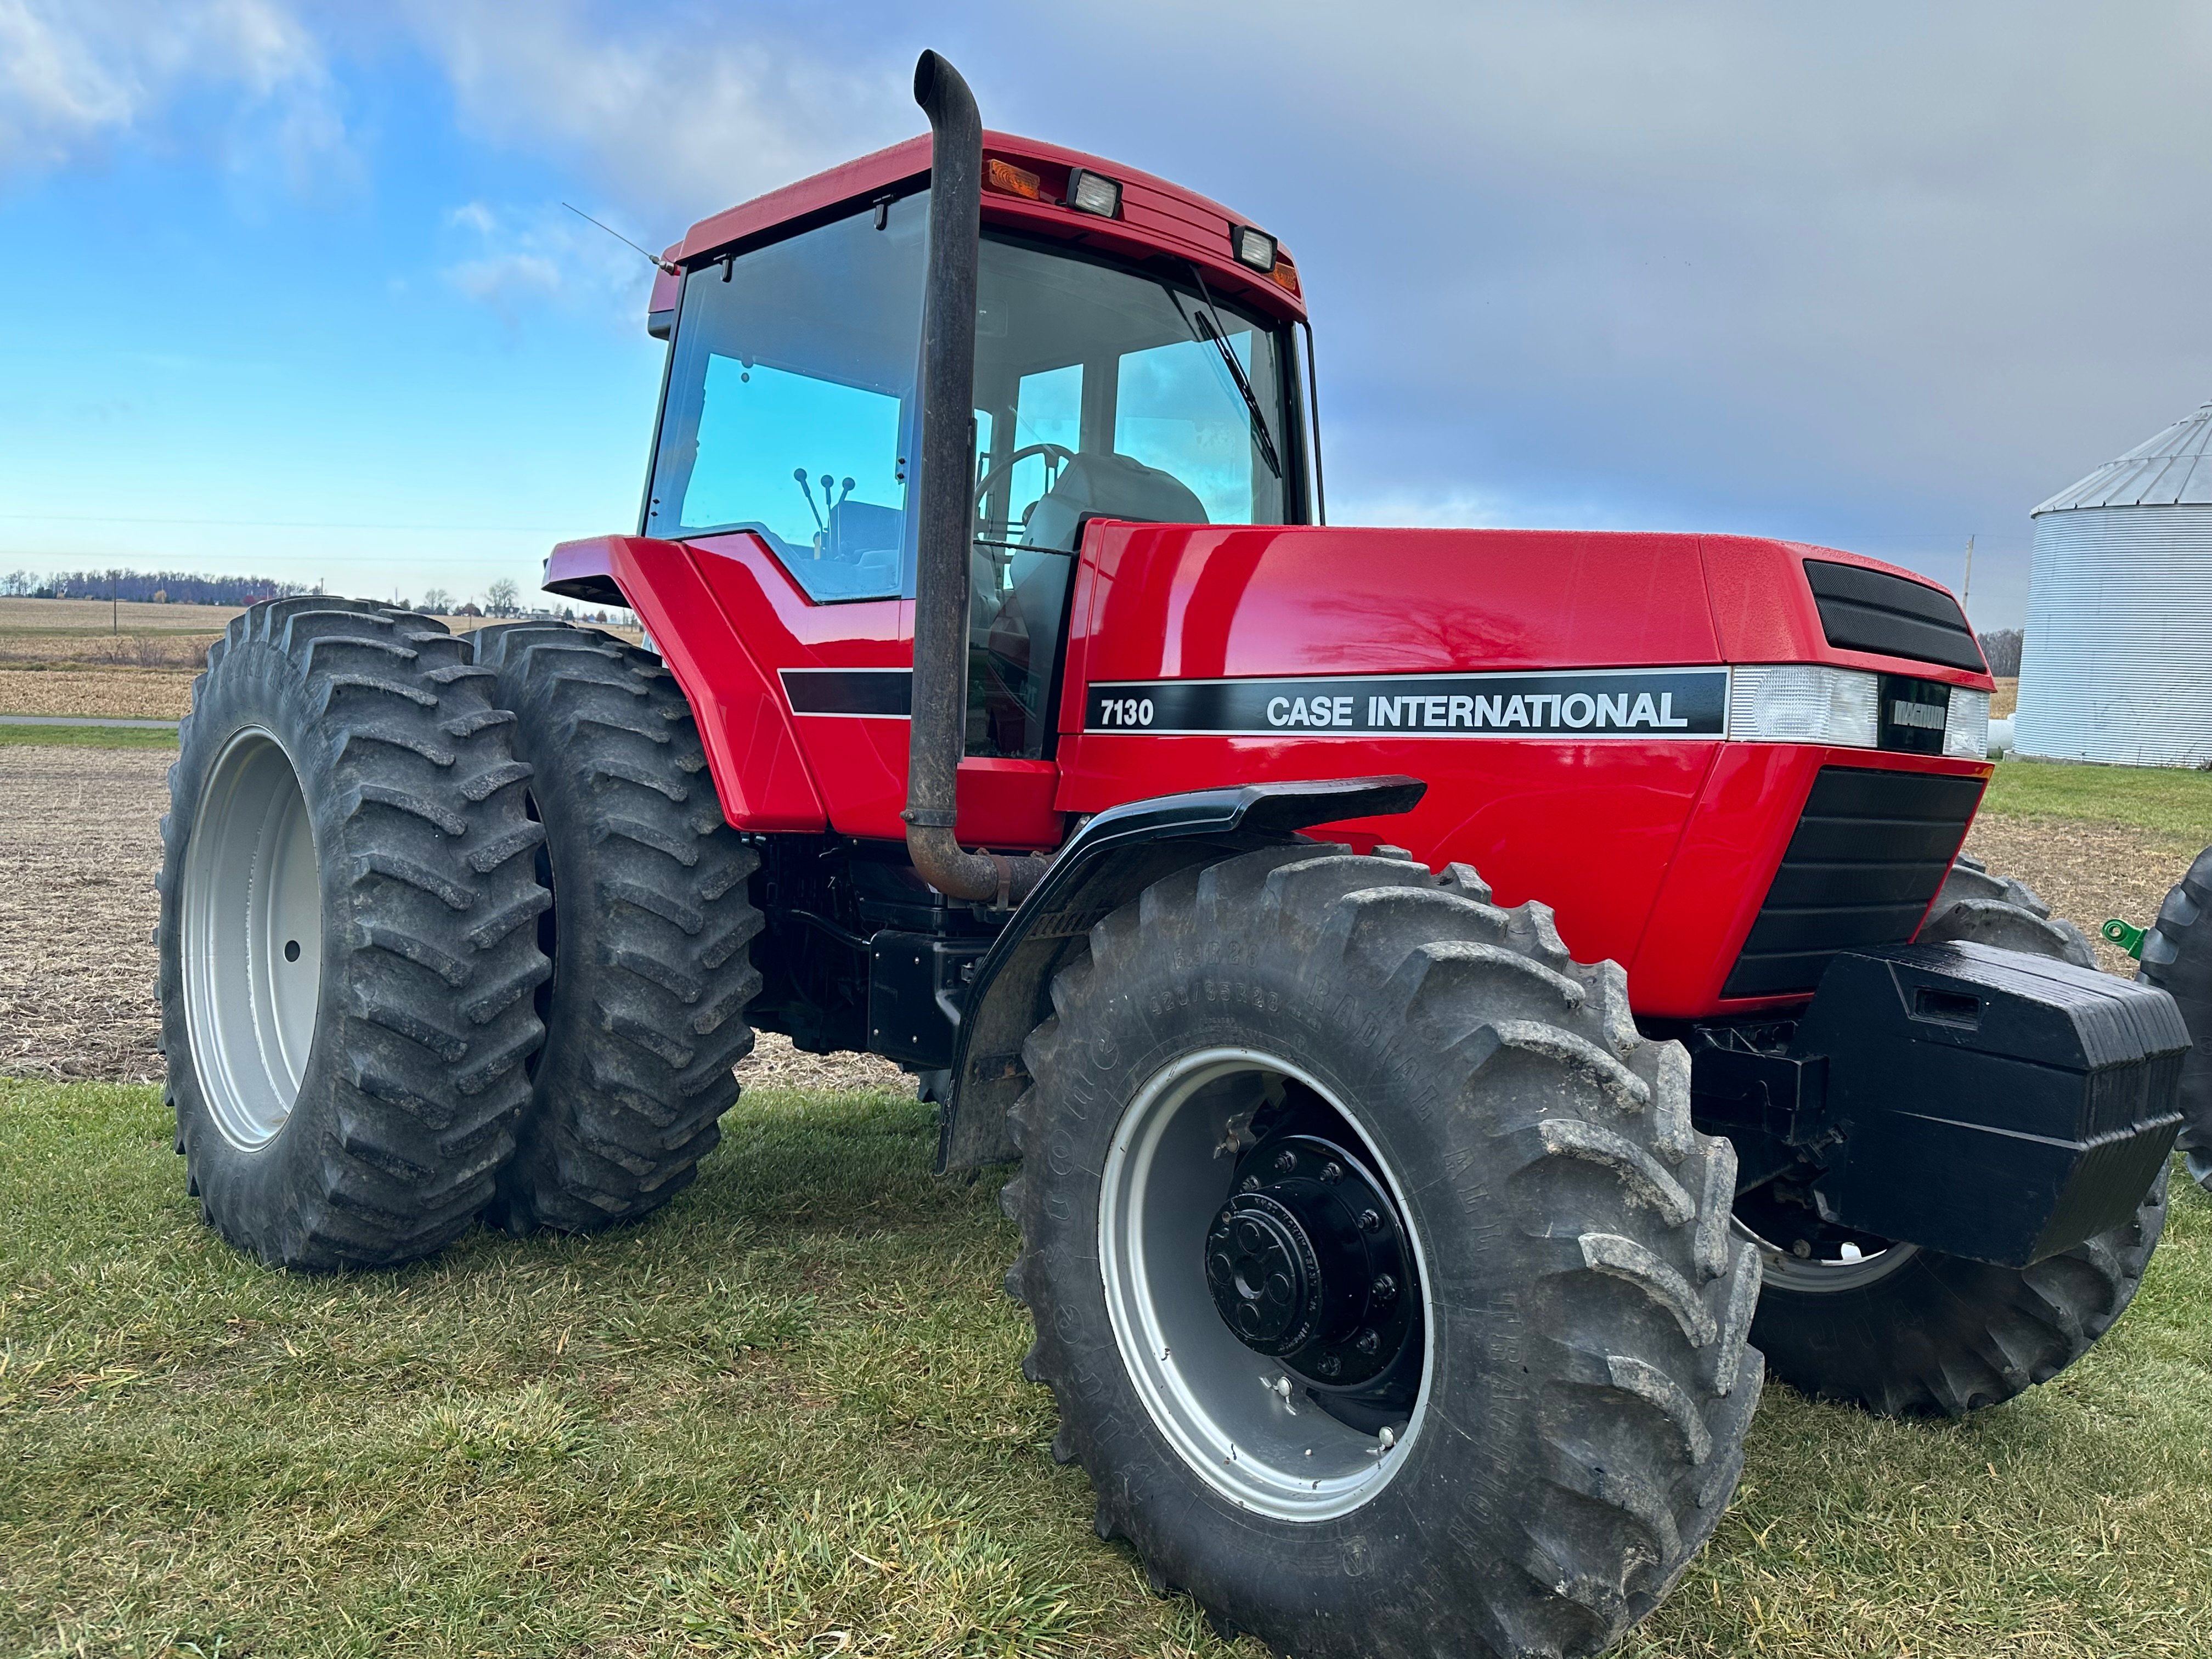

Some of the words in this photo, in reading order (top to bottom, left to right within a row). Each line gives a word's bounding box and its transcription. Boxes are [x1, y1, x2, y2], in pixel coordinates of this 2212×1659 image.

[1102, 699, 1153, 725] 7130
[1267, 696, 1353, 726] CASE
[1368, 693, 1688, 727] INTERNATIONAL
[1893, 701, 1946, 730] MAGNUM
[1306, 974, 1440, 1122] RADIAL
[1443, 1148, 1502, 1251] ALL
